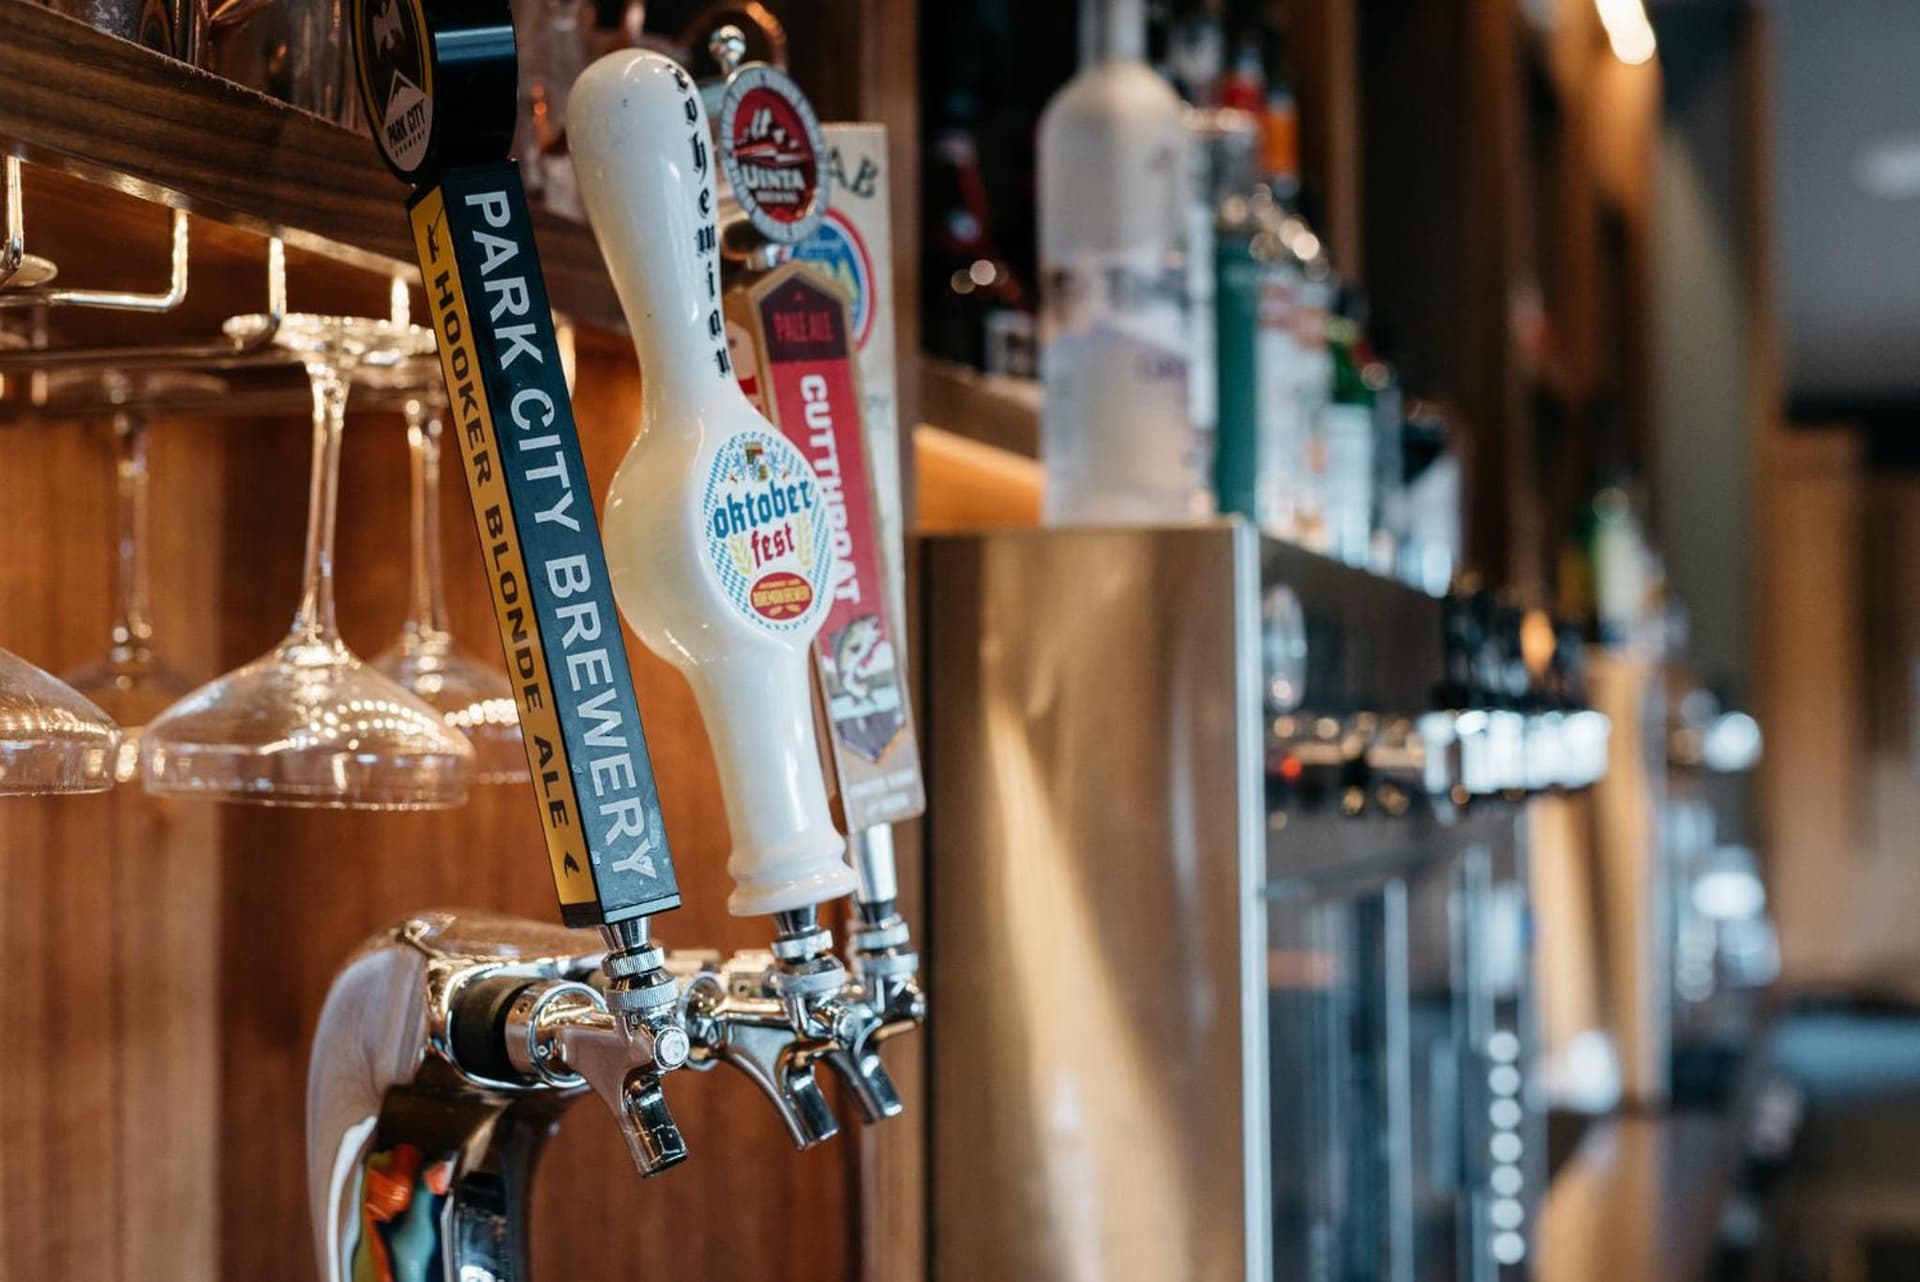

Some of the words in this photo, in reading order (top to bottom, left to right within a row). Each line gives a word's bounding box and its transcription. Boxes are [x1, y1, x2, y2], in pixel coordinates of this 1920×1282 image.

[465, 190, 544, 370] PARK
[510, 388, 581, 533] CITY
[713, 480, 813, 539] oktober
[434, 269, 493, 488] HOOKER
[483, 503, 543, 714] BLONDE
[533, 734, 569, 829] ALE
[751, 522, 796, 568] fest
[545, 553, 659, 880] BREWERY
